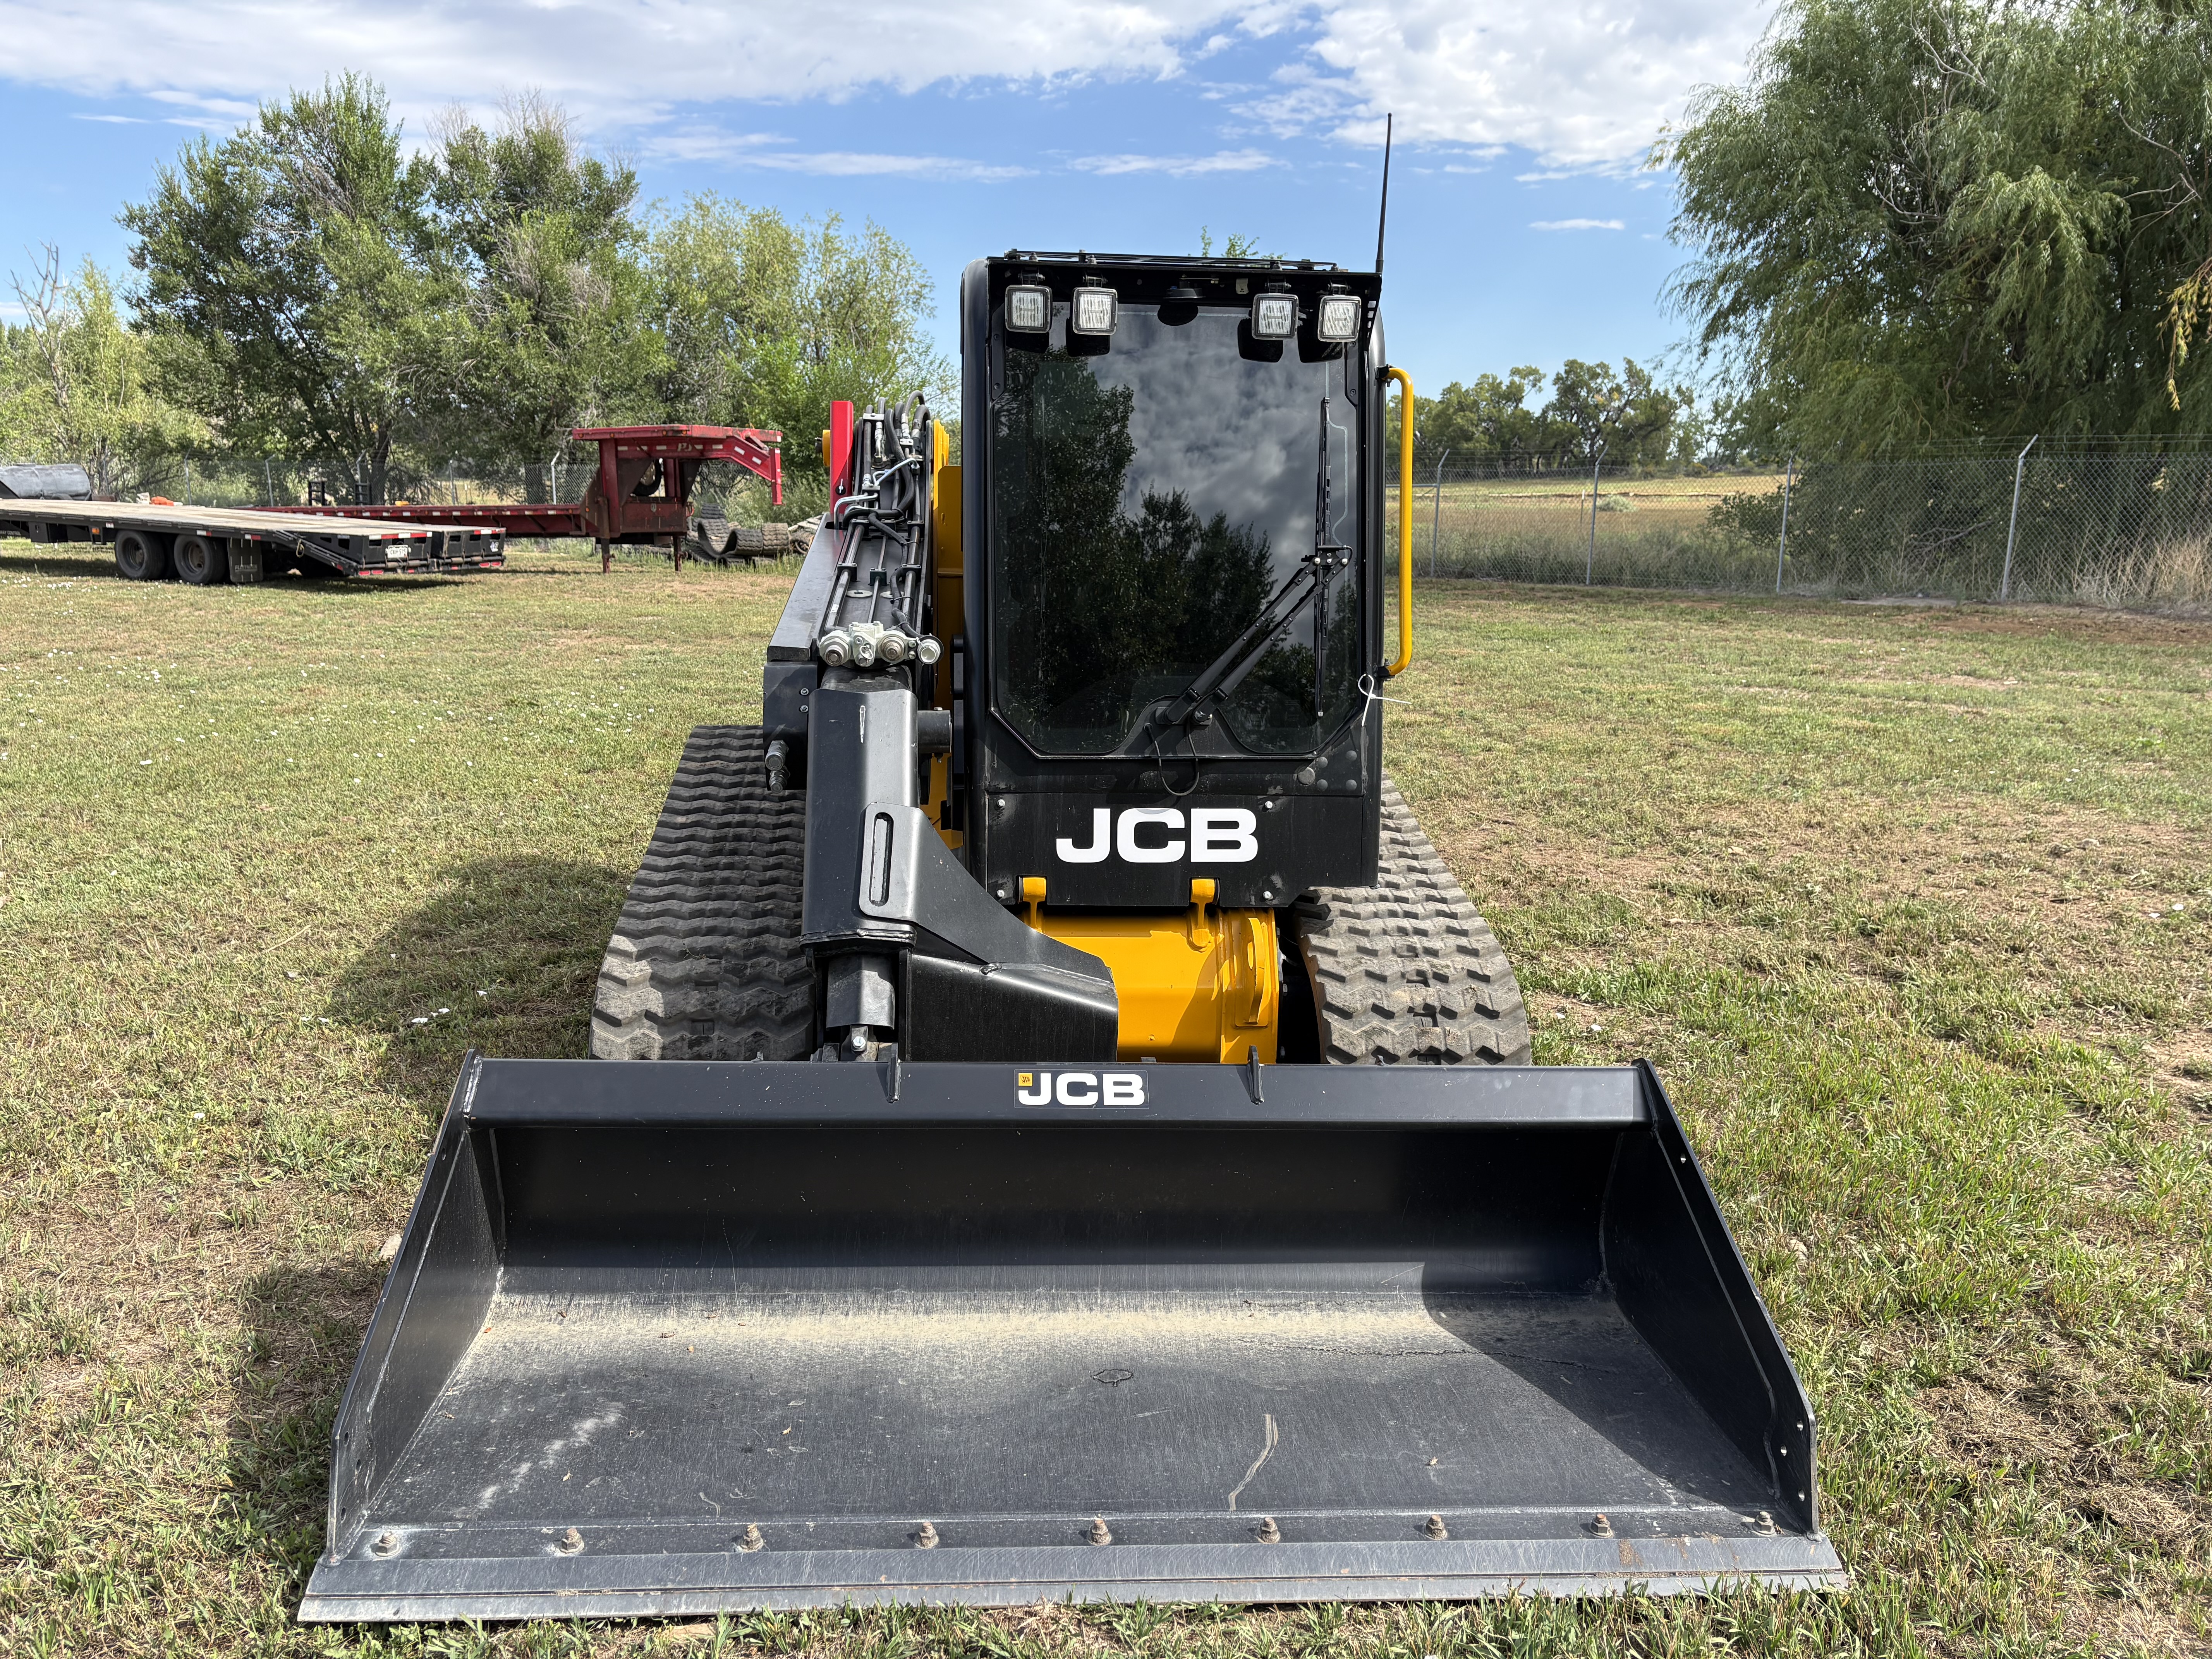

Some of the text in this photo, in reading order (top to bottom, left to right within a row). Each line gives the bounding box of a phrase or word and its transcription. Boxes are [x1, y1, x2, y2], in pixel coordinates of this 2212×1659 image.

[1056, 808, 1258, 863] JCB
[1018, 1073, 1145, 1106] JCB
[1020, 1075, 1030, 1084] JCB
